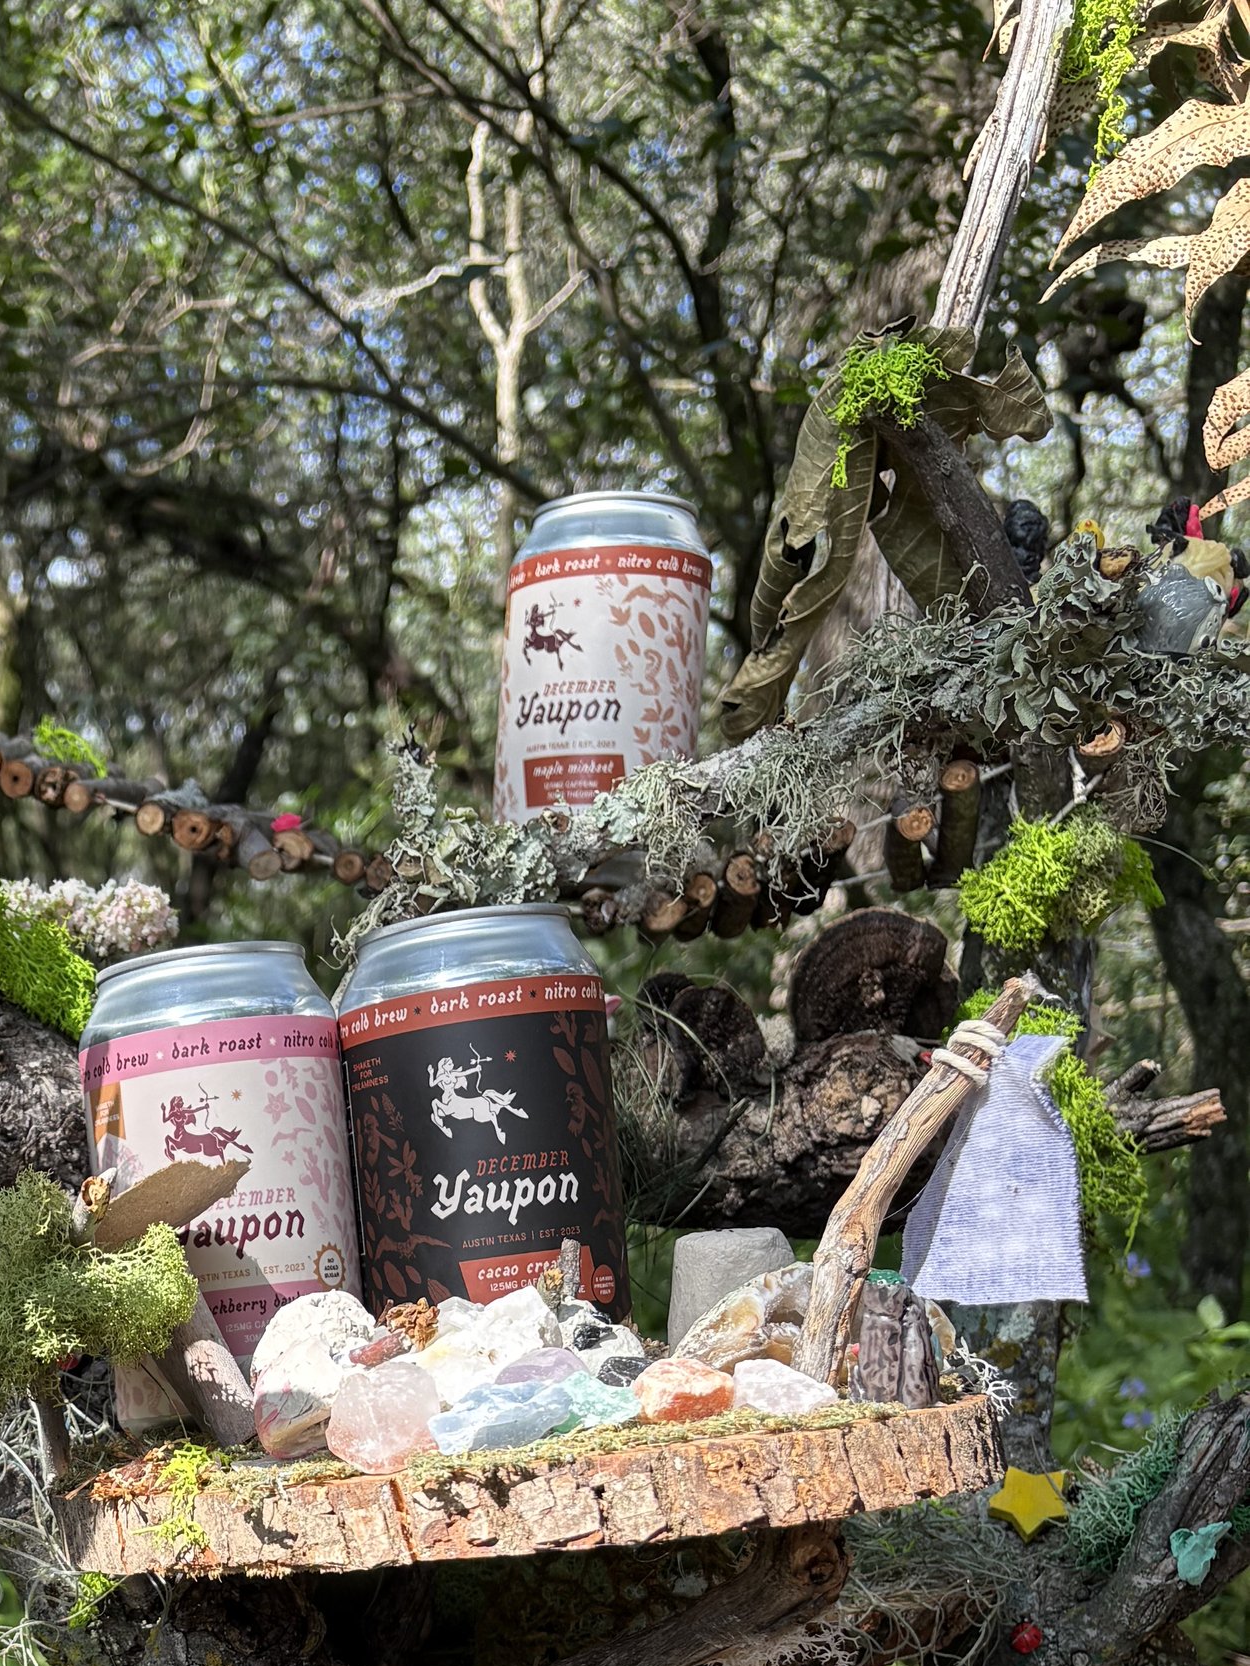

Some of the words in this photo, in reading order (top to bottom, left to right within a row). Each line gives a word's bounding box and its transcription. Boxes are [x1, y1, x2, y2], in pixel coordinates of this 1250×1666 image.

[535, 558, 560, 577] dark
[564, 554, 600, 571] roast
[618, 553, 651, 569] nitro
[543, 680, 616, 697] DECEMBER
[516, 691, 621, 735] Yaupon
[351, 1012, 369, 1034] cold
[374, 1006, 408, 1028] brew
[429, 993, 470, 1015] dark
[477, 985, 523, 1007] roast
[544, 981, 577, 1000] nitro
[93, 1056, 111, 1079] cold
[116, 1052, 149, 1071] brew
[171, 1036, 210, 1060] dark
[218, 1032, 263, 1054] roast
[283, 1029, 314, 1047] nitro
[359, 1070, 373, 1079] FOR
[476, 1150, 570, 1176] DECEMBER
[208, 1187, 296, 1212] ECEMBER
[430, 1169, 579, 1226] Yaupon
[462, 1236, 495, 1249] AUSTIN
[497, 1231, 527, 1244] TEXAS
[539, 1228, 559, 1239] EST.
[560, 1225, 581, 1237] 2023
[222, 1268, 251, 1279] TEXAS
[285, 1262, 306, 1272] 2023
[477, 1263, 519, 1280] cacao
[490, 1281, 518, 1292] 125MG
[209, 1297, 267, 1315] ckberry
